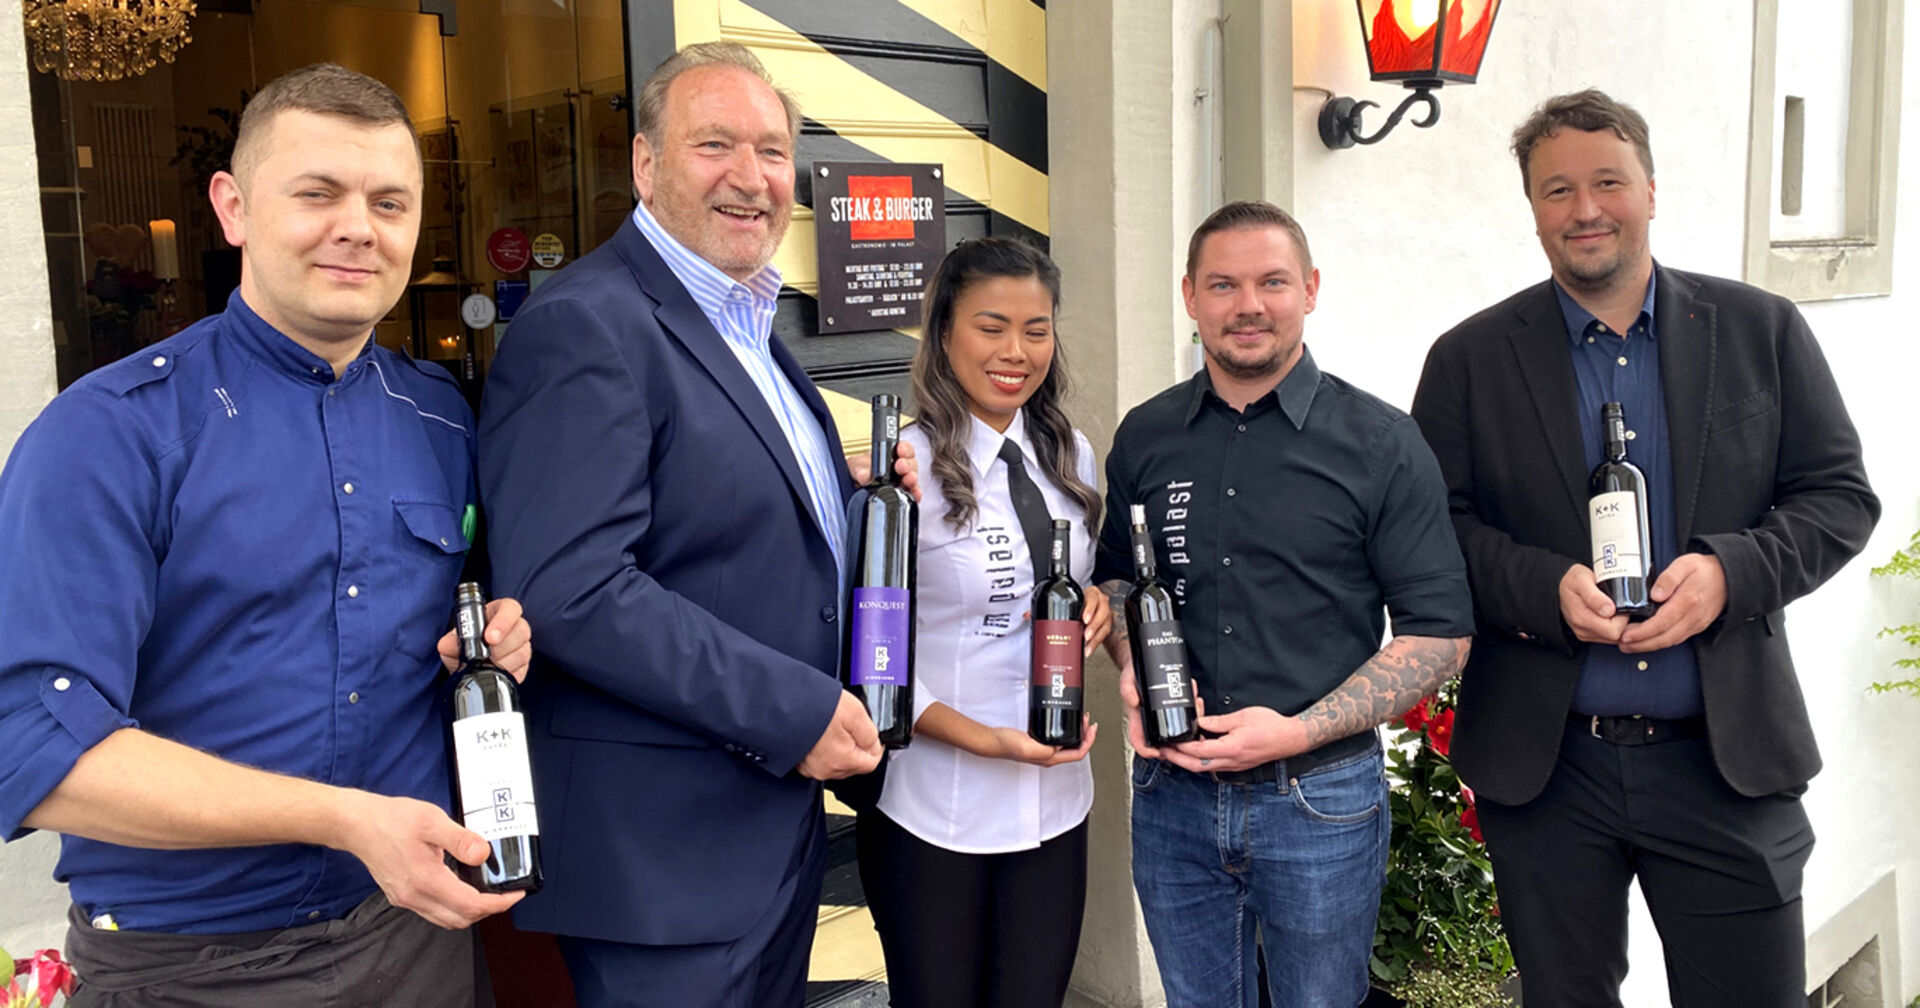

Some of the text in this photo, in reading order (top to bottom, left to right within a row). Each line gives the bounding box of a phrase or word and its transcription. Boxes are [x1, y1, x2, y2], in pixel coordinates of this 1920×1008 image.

[831, 196, 934, 222] STEAK & BURGER
[1162, 480, 1194, 564] palast
[976, 526, 1020, 603] palast
[859, 601, 905, 611] KONQUEST
[497, 792, 508, 802] K
[500, 807, 510, 818] K
